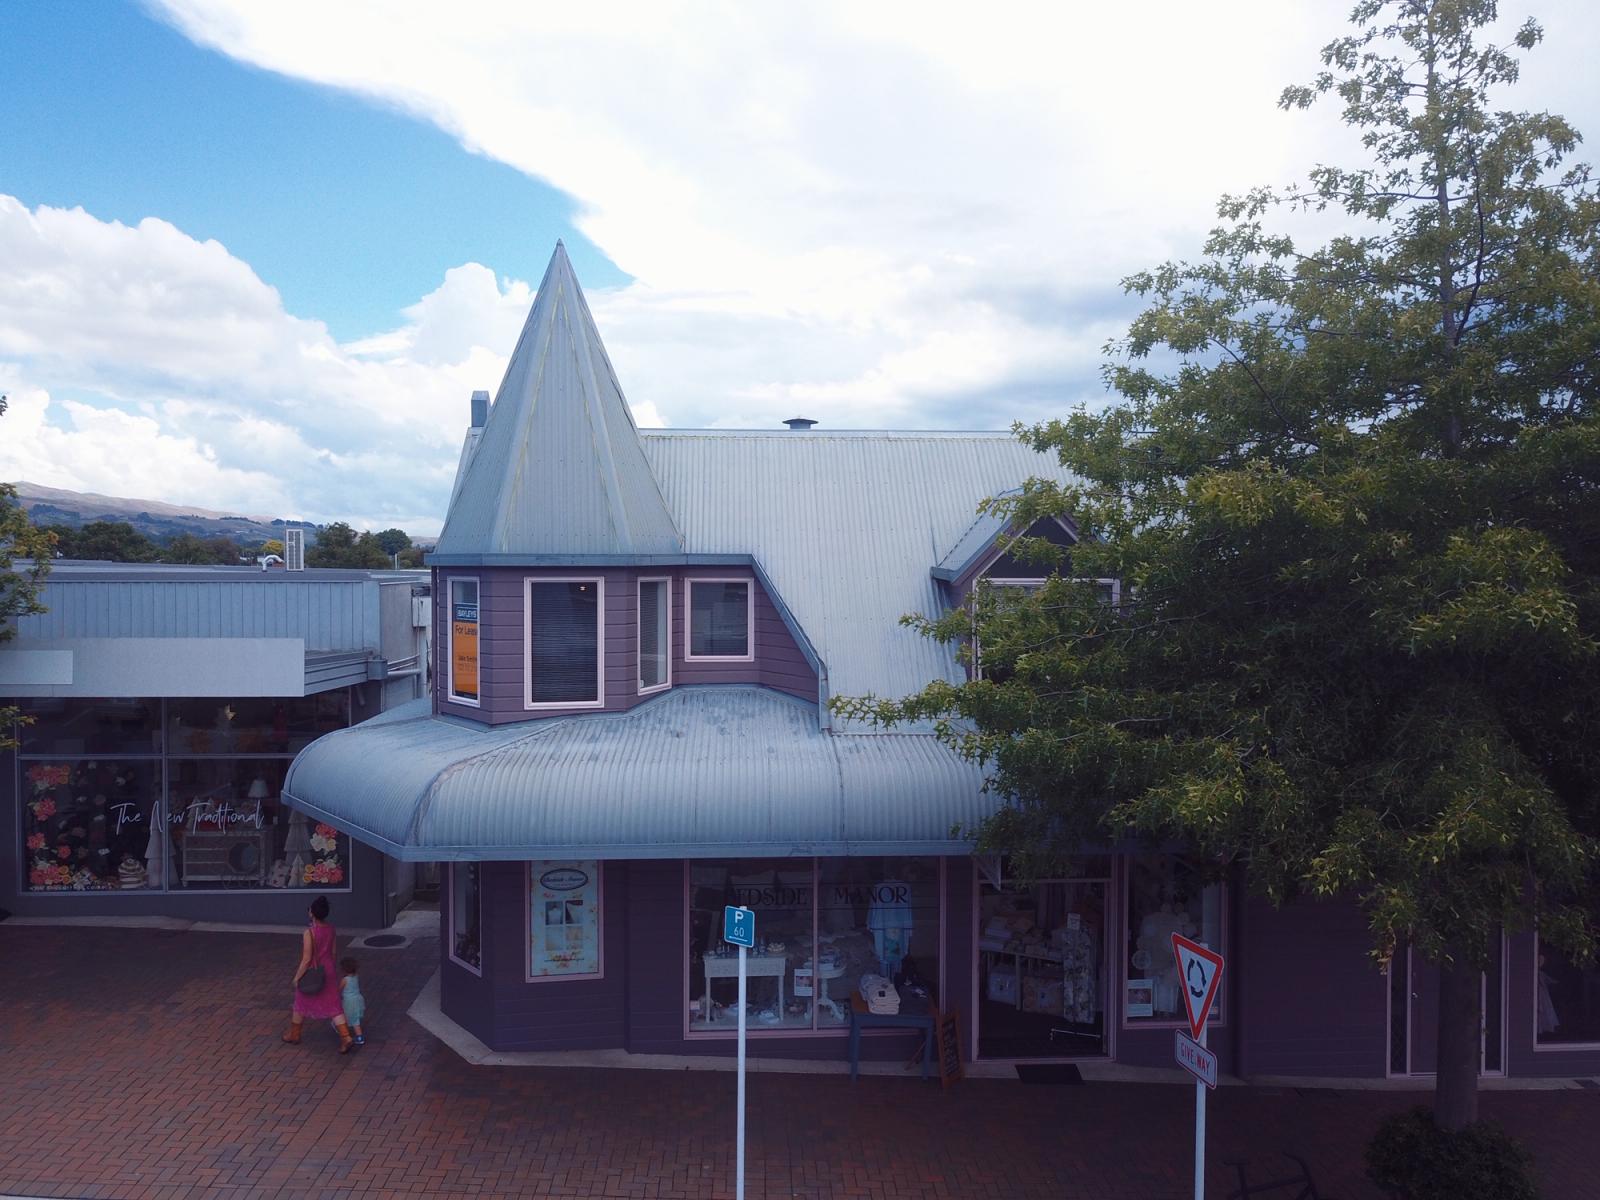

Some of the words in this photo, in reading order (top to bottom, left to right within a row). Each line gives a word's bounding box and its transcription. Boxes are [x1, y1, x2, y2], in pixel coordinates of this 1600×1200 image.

[455, 624, 464, 634] For
[110, 802, 142, 836] The
[149, 800, 185, 833] New
[186, 799, 265, 835] Traditional
[834, 886, 908, 904] MANOR
[734, 910, 744, 924] P
[733, 926, 745, 938] 60
[1181, 1043, 1194, 1064] GIVE
[1196, 1053, 1211, 1075] WAY
